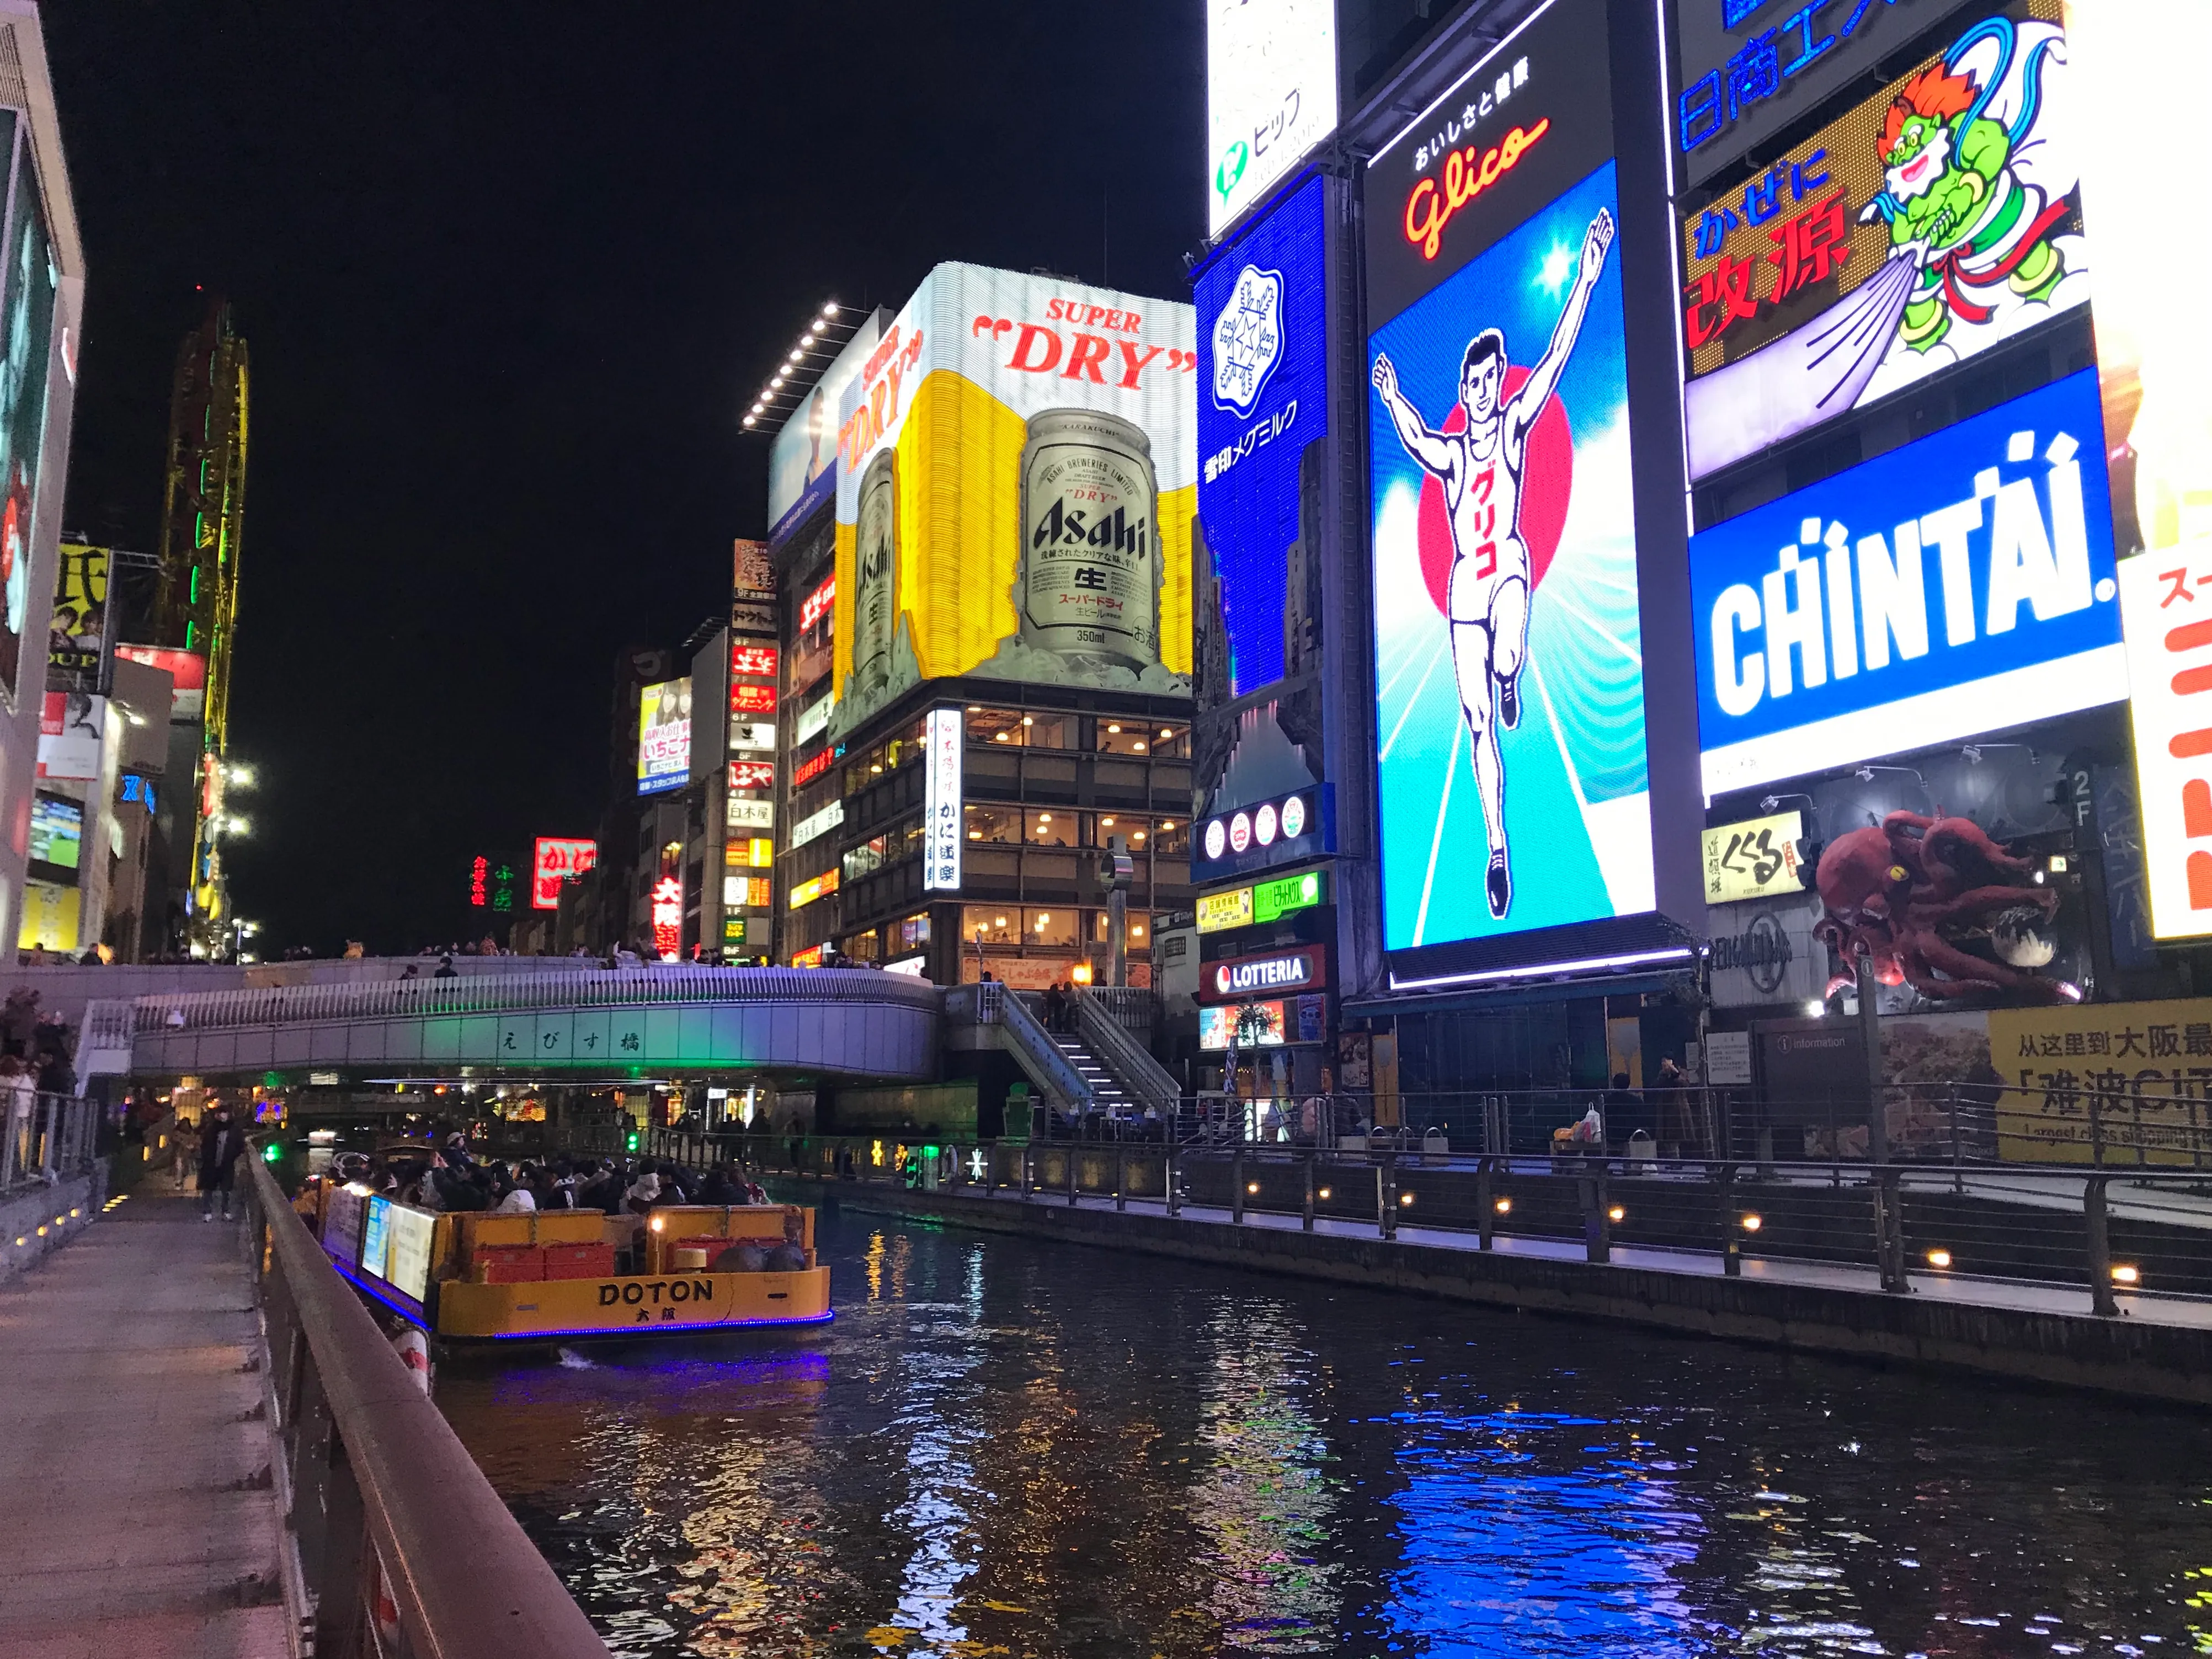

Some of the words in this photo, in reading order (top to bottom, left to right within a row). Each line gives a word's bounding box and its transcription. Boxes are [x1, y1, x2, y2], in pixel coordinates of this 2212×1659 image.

[1415, 56, 1529, 171] おいしさと健康
[1694, 149, 1829, 260] かぜに
[1684, 187, 1849, 349] 改源
[1046, 298, 1142, 334] SUPER
[1204, 400, 1297, 484] 雪印メグミルク
[1047, 465, 1064, 484] ASAHI
[1067, 458, 1108, 472] BREWERIES
[1111, 469, 1134, 495] LIMITED
[1033, 497, 1146, 562] Asahi
[1471, 459, 1497, 580] グリコ
[1074, 567, 1107, 591] 生
[1059, 594, 1124, 611] スーパードライ
[1075, 607, 1104, 618] 生ビール
[734, 637, 749, 646] 8F
[1077, 630, 1105, 644] 350ml
[732, 697, 775, 711] ダイニング
[644, 721, 692, 742] 高収入お仕事
[731, 765, 772, 787] はや
[729, 790, 745, 798] 4F
[731, 804, 769, 820] 白木屋
[799, 819, 816, 844] 白木屋
[1721, 828, 1783, 885] くくる
[1274, 881, 1300, 908] ピタットハウス
[1742, 886, 1765, 895] KUKURU
[1233, 958, 1303, 987] LOTTERIA
[503, 1032, 639, 1051] えびす橋
[599, 1279, 713, 1306] DOTON
